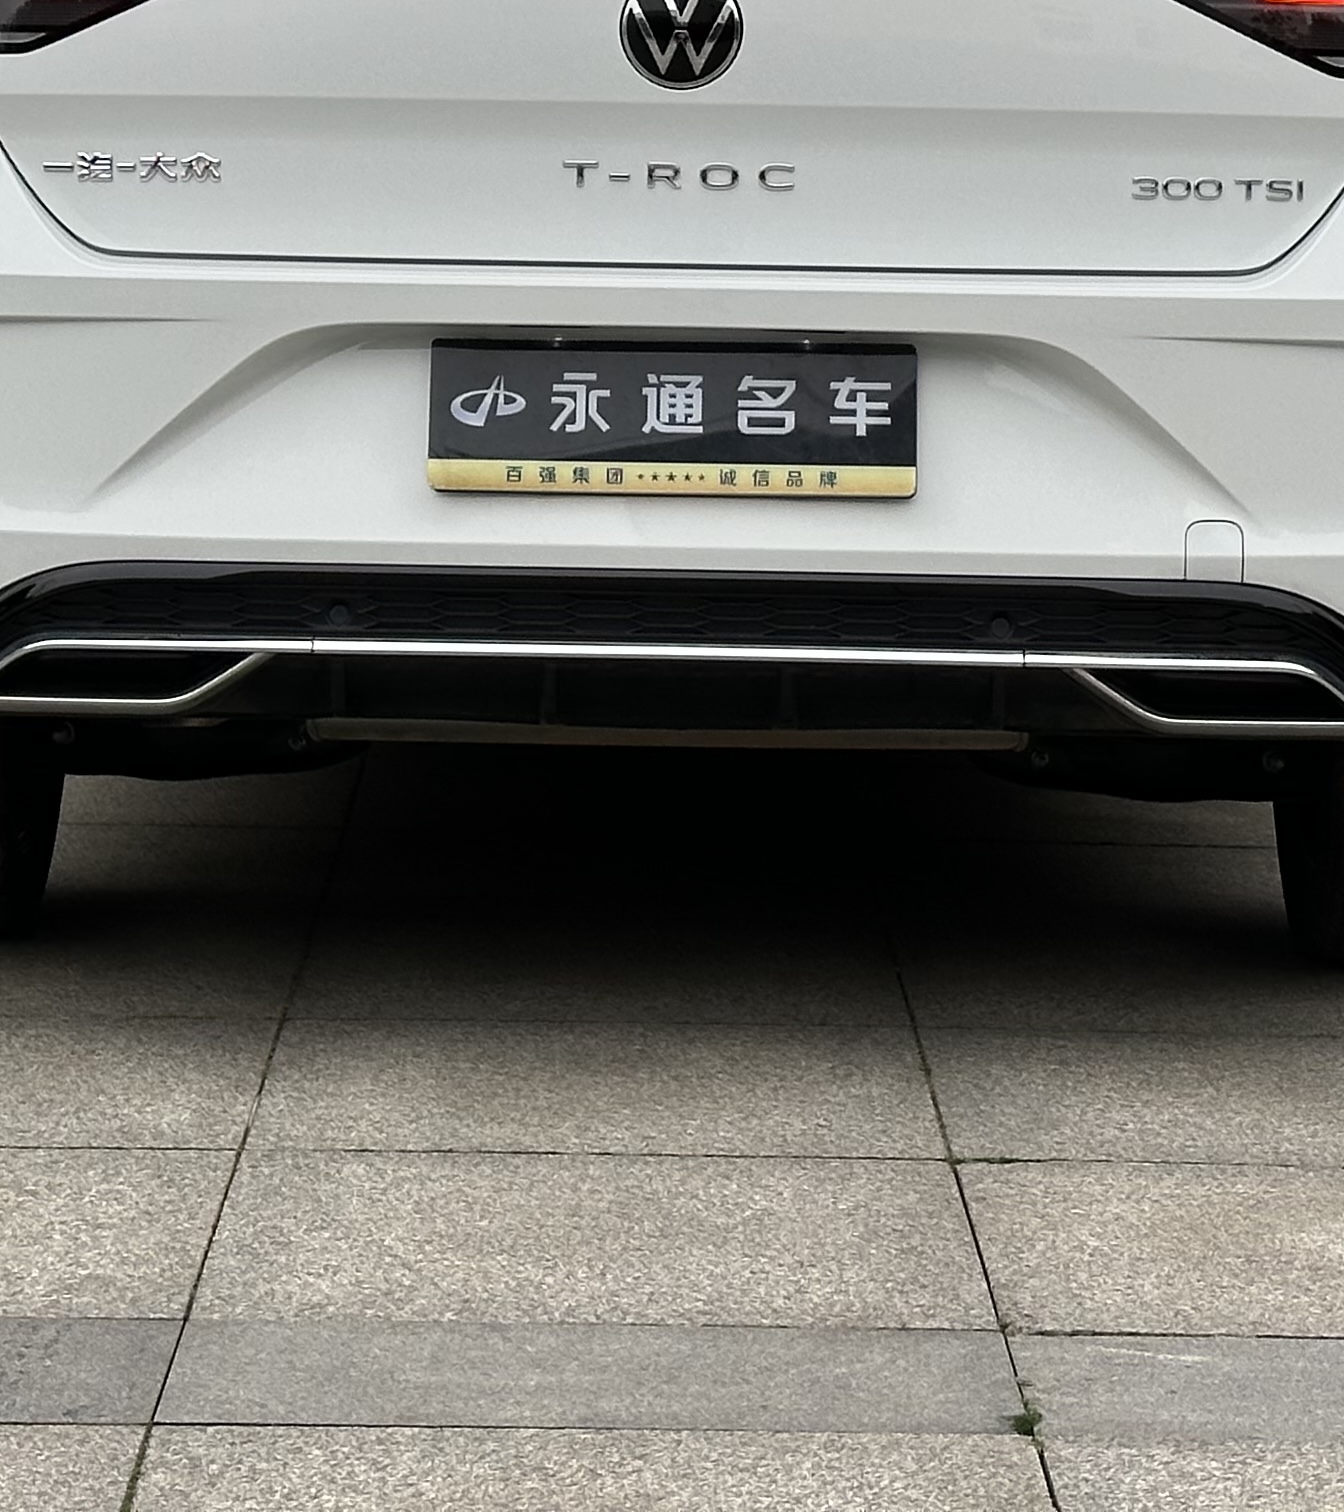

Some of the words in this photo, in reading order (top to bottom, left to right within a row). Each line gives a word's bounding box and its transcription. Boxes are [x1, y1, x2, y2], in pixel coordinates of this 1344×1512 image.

[42, 151, 222, 183] 一汽-大众
[562, 159, 796, 192] T-ROC
[1131, 176, 1224, 201] 300
[1233, 178, 1305, 203] TSI
[549, 370, 892, 437] 永通名车
[505, 464, 624, 486] 百强集团
[718, 467, 840, 489] 诚信品牌
